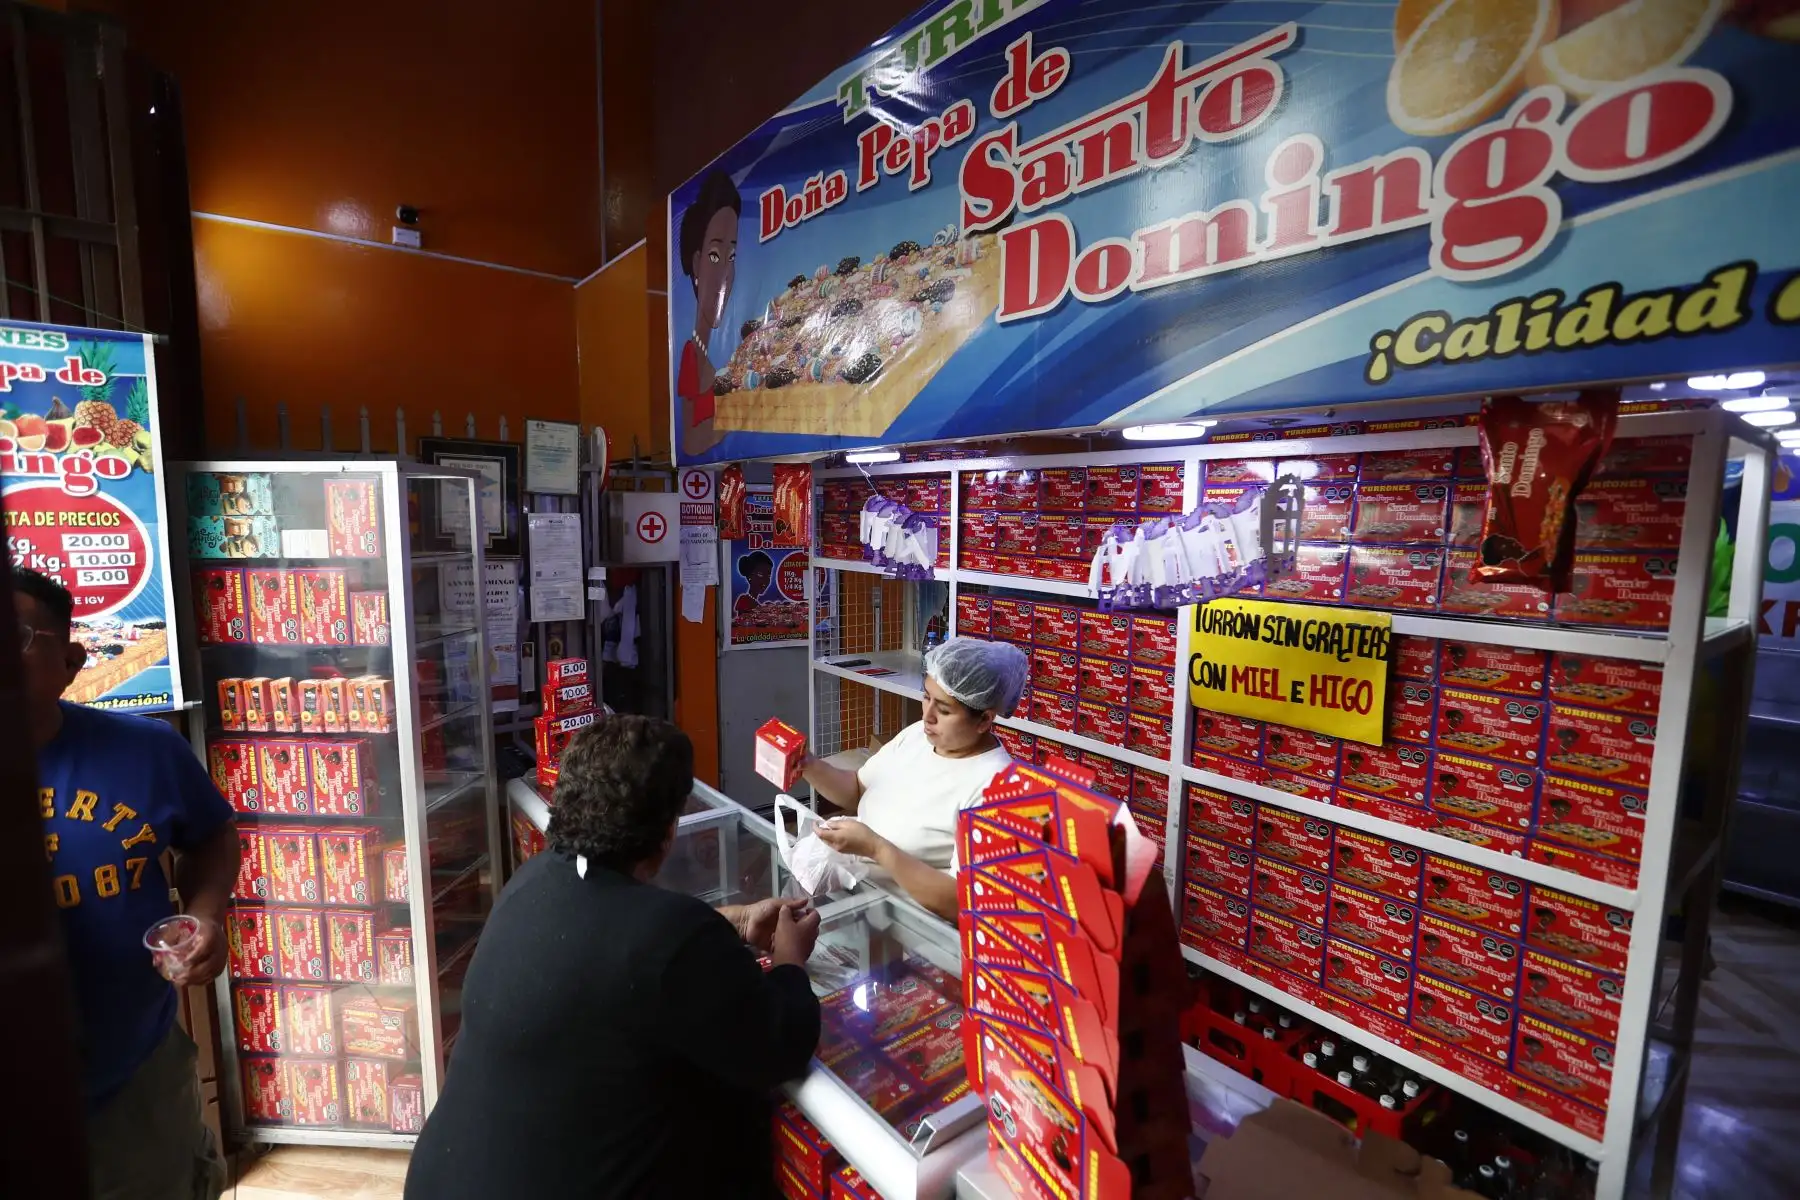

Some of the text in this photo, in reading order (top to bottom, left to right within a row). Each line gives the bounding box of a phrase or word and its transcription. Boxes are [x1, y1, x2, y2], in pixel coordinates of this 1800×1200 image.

[759, 32, 1070, 243] Doña Pepa de
[960, 21, 1298, 238] Santo
[997, 67, 1733, 324] Domingo
[1364, 259, 1759, 385] ¡Calidad
[55, 356, 106, 386] de
[1491, 441, 1519, 484] Santo
[1511, 428, 1547, 499] Domingo
[34, 511, 55, 527] DE
[59, 511, 120, 527] PRECIOS
[68, 535, 125, 547] 20.00
[30, 554, 67, 572] Kg.
[76, 554, 131, 566] 10.00
[1576, 555, 1637, 564] URRONES
[83, 570, 126, 583] 5.00
[84, 596, 105, 605] IGV
[1195, 600, 1260, 641] TURRÓN
[1262, 614, 1301, 648] SIN
[564, 663, 585, 674] 5.00
[564, 687, 586, 698] 10.00
[1189, 652, 1374, 716] CON MIEL E HIGO
[1445, 690, 1500, 705] TURRONES
[564, 715, 592, 728] 20.00
[1555, 705, 1623, 725] TURRONES
[1439, 753, 1495, 771] TURRONES
[1548, 775, 1615, 797] TURRONES
[1260, 806, 1301, 824] TURRONES
[1338, 829, 1387, 848] TURRONES
[1257, 857, 1298, 876] TURRONES
[1428, 855, 1484, 877] TURRONES
[1334, 883, 1381, 904] TURRONES
[1534, 886, 1601, 912] TURRONES
[1254, 910, 1295, 930] TURRONES
[1423, 914, 1479, 939] TURRONES
[1330, 939, 1377, 962] TURRONES
[1527, 950, 1594, 980] TURRONES
[1417, 973, 1473, 1001] TURRONES
[1523, 1014, 1588, 1046] TURRONES
